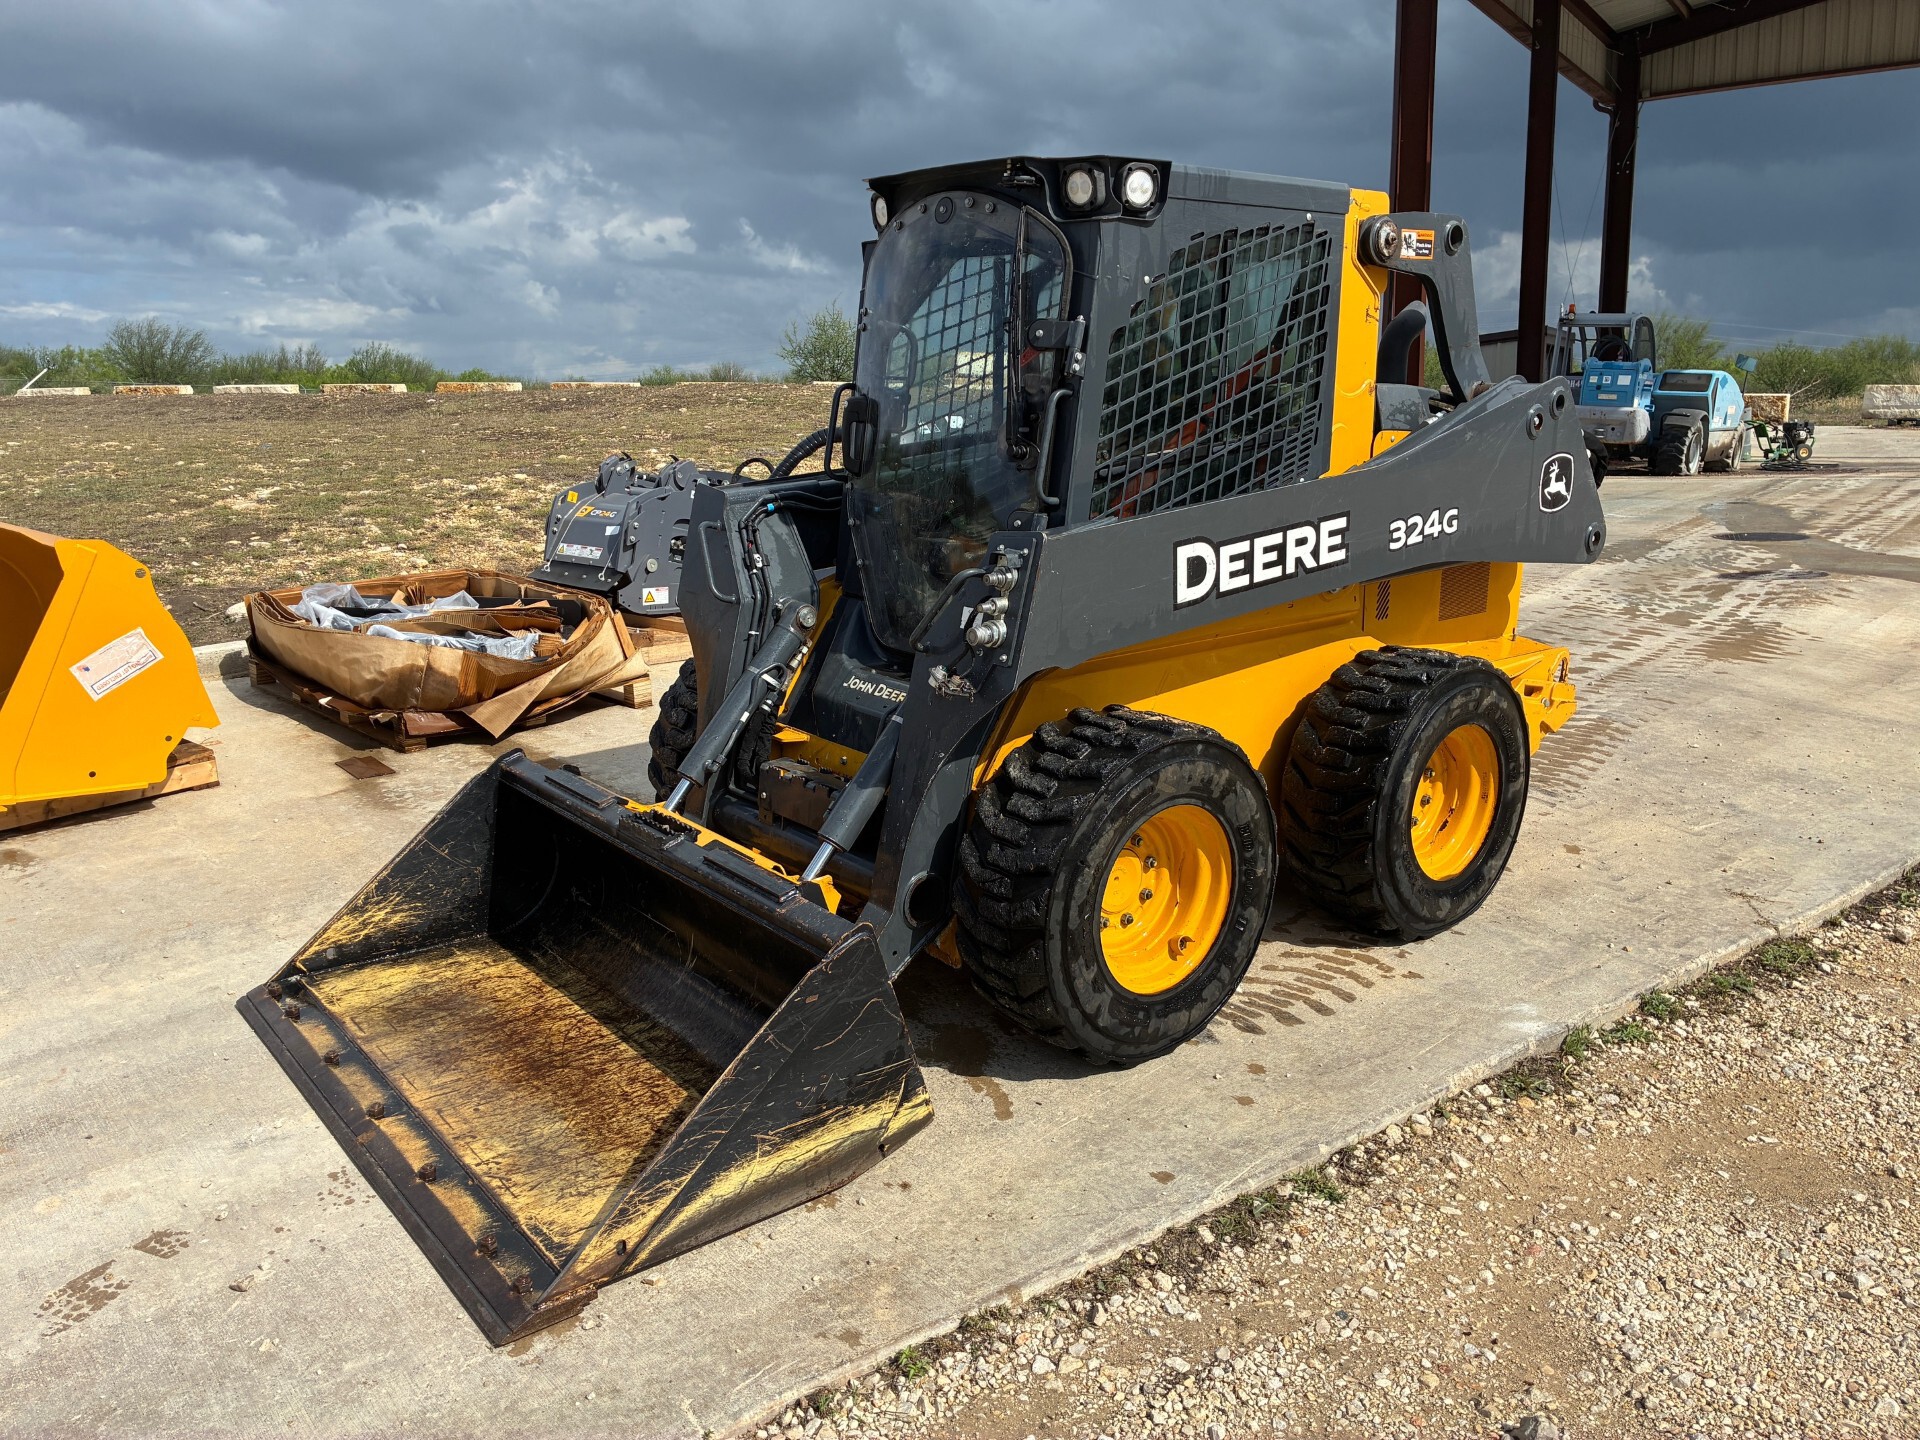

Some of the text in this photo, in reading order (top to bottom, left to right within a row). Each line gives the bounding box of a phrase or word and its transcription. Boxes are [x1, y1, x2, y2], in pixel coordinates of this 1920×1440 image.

[1389, 507, 1459, 550] 324G
[1176, 516, 1347, 604] DEERE
[843, 675, 907, 703] JOHN DEER
